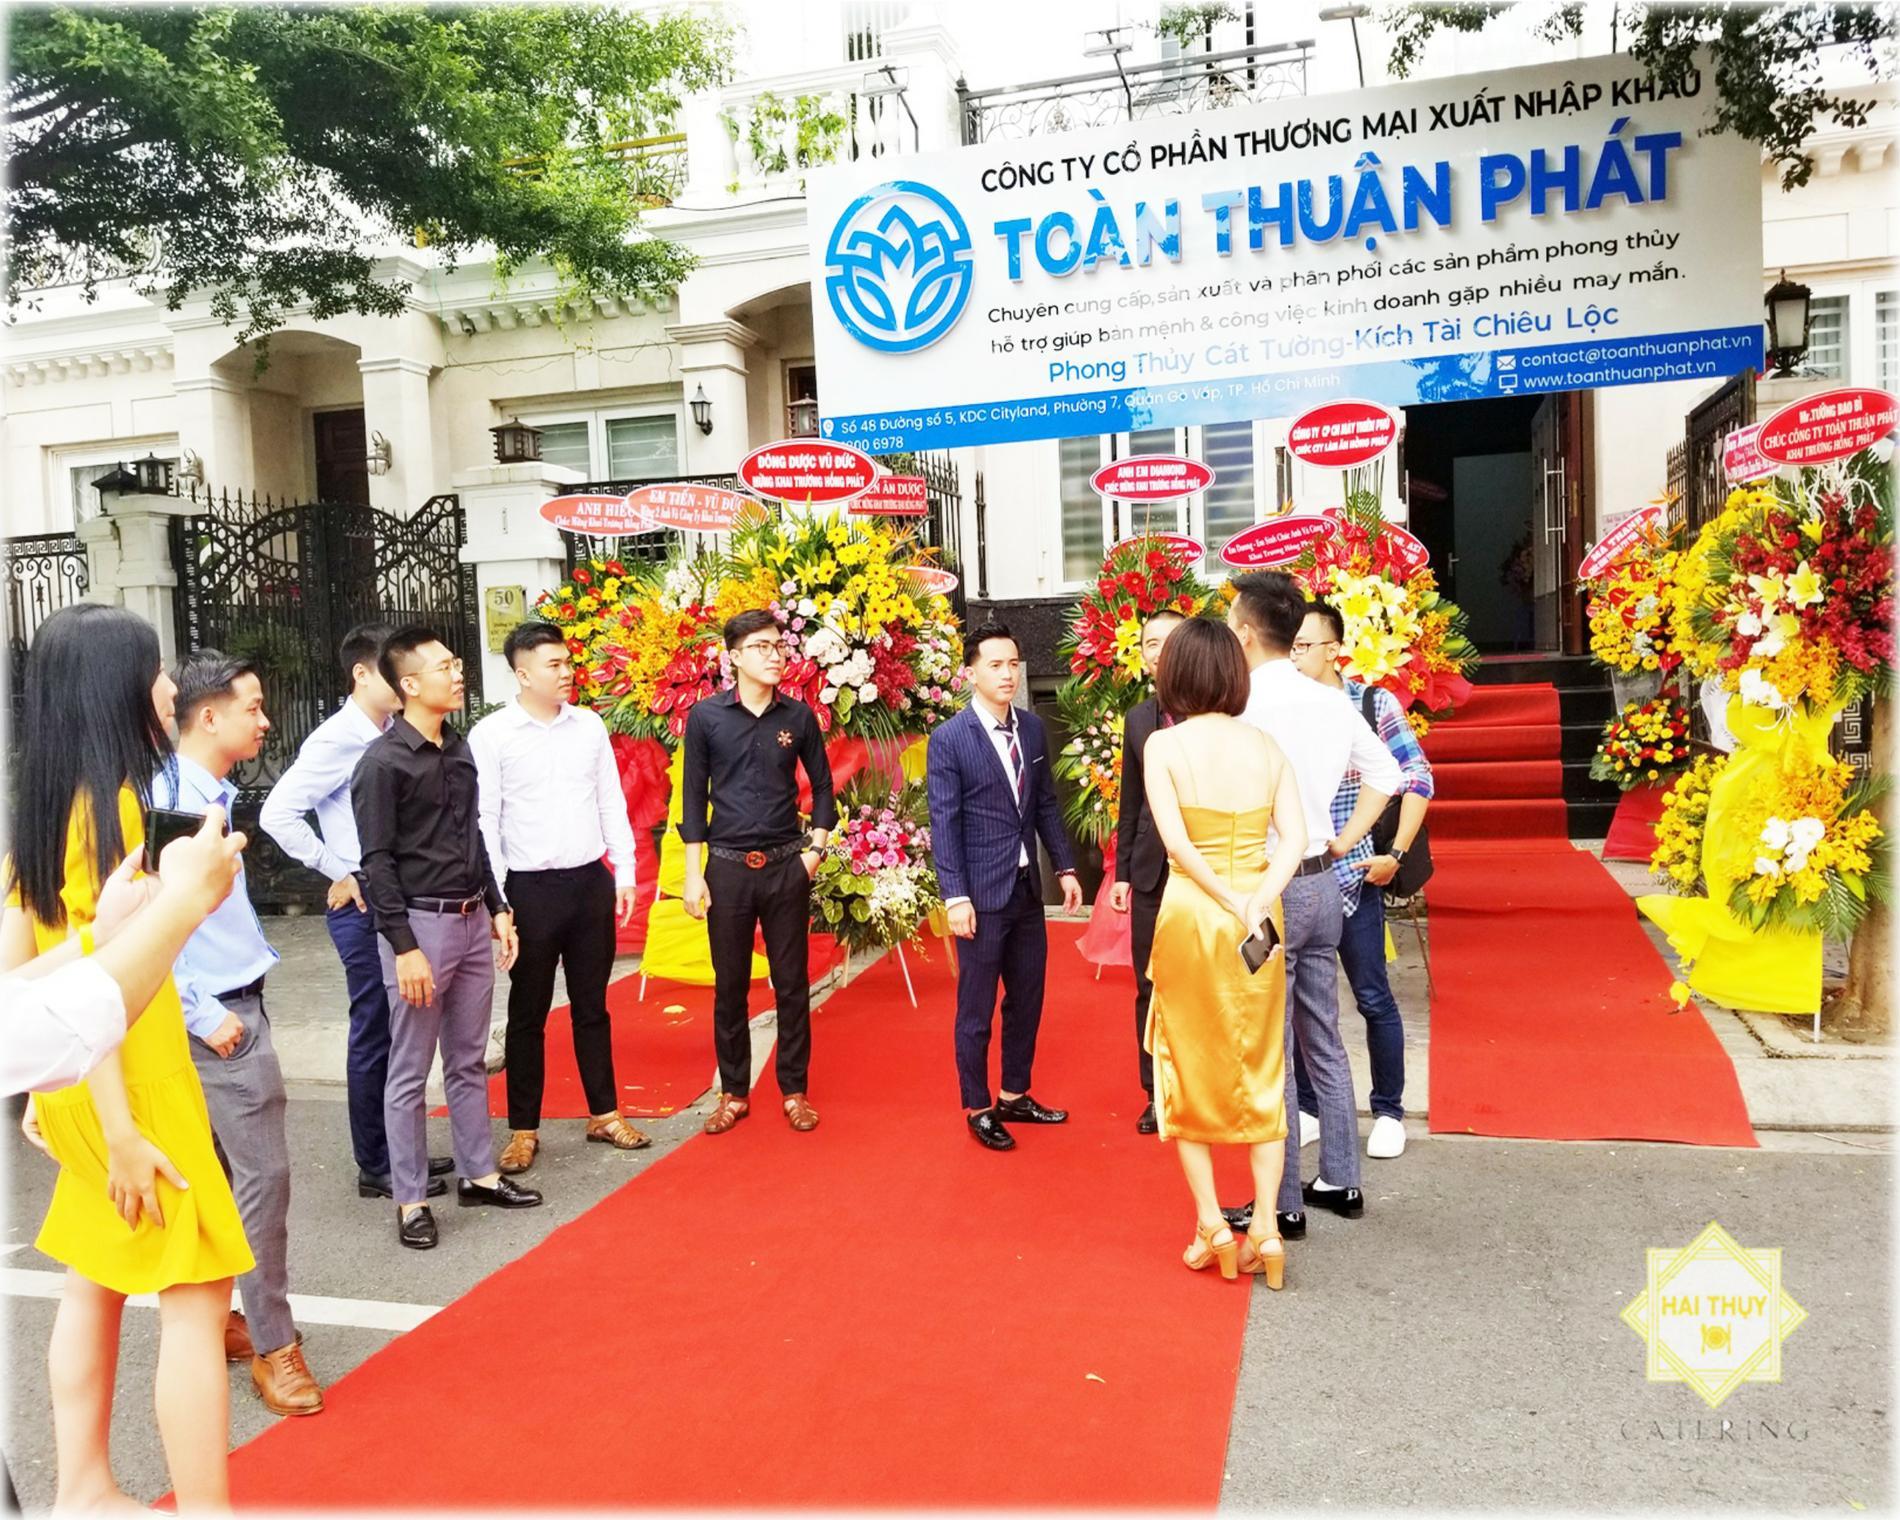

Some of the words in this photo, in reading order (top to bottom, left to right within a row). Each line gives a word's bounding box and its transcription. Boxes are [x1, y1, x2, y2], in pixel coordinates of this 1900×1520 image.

[981, 161, 1054, 192] CÔNG
[1061, 155, 1095, 181] TY
[1103, 140, 1141, 175] CỔ
[1151, 128, 1227, 169] PHẦN
[1235, 117, 1351, 157] THƯƠNG
[1363, 108, 1416, 140] MẠI
[1428, 87, 1505, 131] XUẤT
[1514, 80, 1602, 120] NHẬP
[993, 188, 1182, 282] TOÀN
[1202, 151, 1452, 257] THUẬN
[1480, 116, 1682, 224] PHÁT
[988, 302, 1059, 323] Chuyên
[1064, 299, 1111, 316] cung
[1198, 279, 1242, 298] xuất
[1250, 275, 1272, 292] và
[1280, 270, 1330, 292] phân
[1338, 260, 1382, 286] phối
[1389, 257, 1426, 275] các
[1433, 252, 1470, 271] sản
[1477, 243, 1539, 270] phẩm
[1545, 239, 1618, 263] phong
[1626, 230, 1680, 250] thủy
[991, 335, 1014, 353] hỗ
[1021, 335, 1048, 353] trợ
[1053, 330, 1092, 351] giúp
[1099, 327, 1134, 342] bản
[1139, 318, 1194, 339] mệnh
[1200, 316, 1214, 331] &
[1219, 307, 1269, 328] công
[1275, 304, 1317, 324] việc
[1324, 298, 1367, 317] kinh
[1373, 289, 1440, 311] doanh
[1448, 286, 1489, 306] gặp
[1499, 273, 1561, 297] nhiều
[1573, 272, 1621, 290] may
[1629, 260, 1686, 284] mắn.
[1049, 359, 1126, 383] Phong
[1133, 347, 1195, 374] Thủy
[1205, 341, 1249, 365] Cát
[1423, 317, 1461, 343] Tài
[1472, 310, 1551, 338] Chiêu
[1567, 304, 1619, 334] Lộc
[1521, 334, 1752, 368] contact@toanthuanphat.vn
[1523, 359, 1716, 389] www.toanthuanphat.vn
[841, 420, 857, 435] Số
[861, 418, 877, 433] 48
[880, 414, 923, 432] Đường
[926, 411, 941, 426] số
[945, 411, 957, 427] 5,
[960, 408, 987, 424] KDC
[991, 403, 1051, 423] Cityland,
[1053, 396, 1106, 414] Phường
[1110, 396, 1121, 410] 7,
[1125, 389, 1164, 409] Quận
[1228, 383, 1250, 397] TP.
[1252, 376, 1271, 395] Hồ
[1275, 374, 1301, 392] Chí
[1305, 373, 1341, 389] Minh
[1837, 401, 1852, 416] BAO
[873, 436, 904, 451] 6978
[1764, 431, 1787, 449] CHÚC
[1788, 427, 1811, 445] CÔNG
[1812, 426, 1824, 439] TY
[1825, 419, 1846, 436] TOÀN
[1848, 412, 1875, 432] THUẬN
[1786, 448, 1803, 460] KHAI
[1856, 431, 1875, 446] PHÁT
[788, 453, 816, 472] DƯỢC
[1118, 466, 1134, 478] ANH
[1136, 465, 1148, 477] EM
[1150, 464, 1187, 477] DIAMOND
[775, 476, 793, 488] KHAI
[846, 473, 865, 488] PHÁT
[577, 502, 600, 515] ANH
[650, 490, 666, 503] EM
[495, 590, 514, 605] 50
